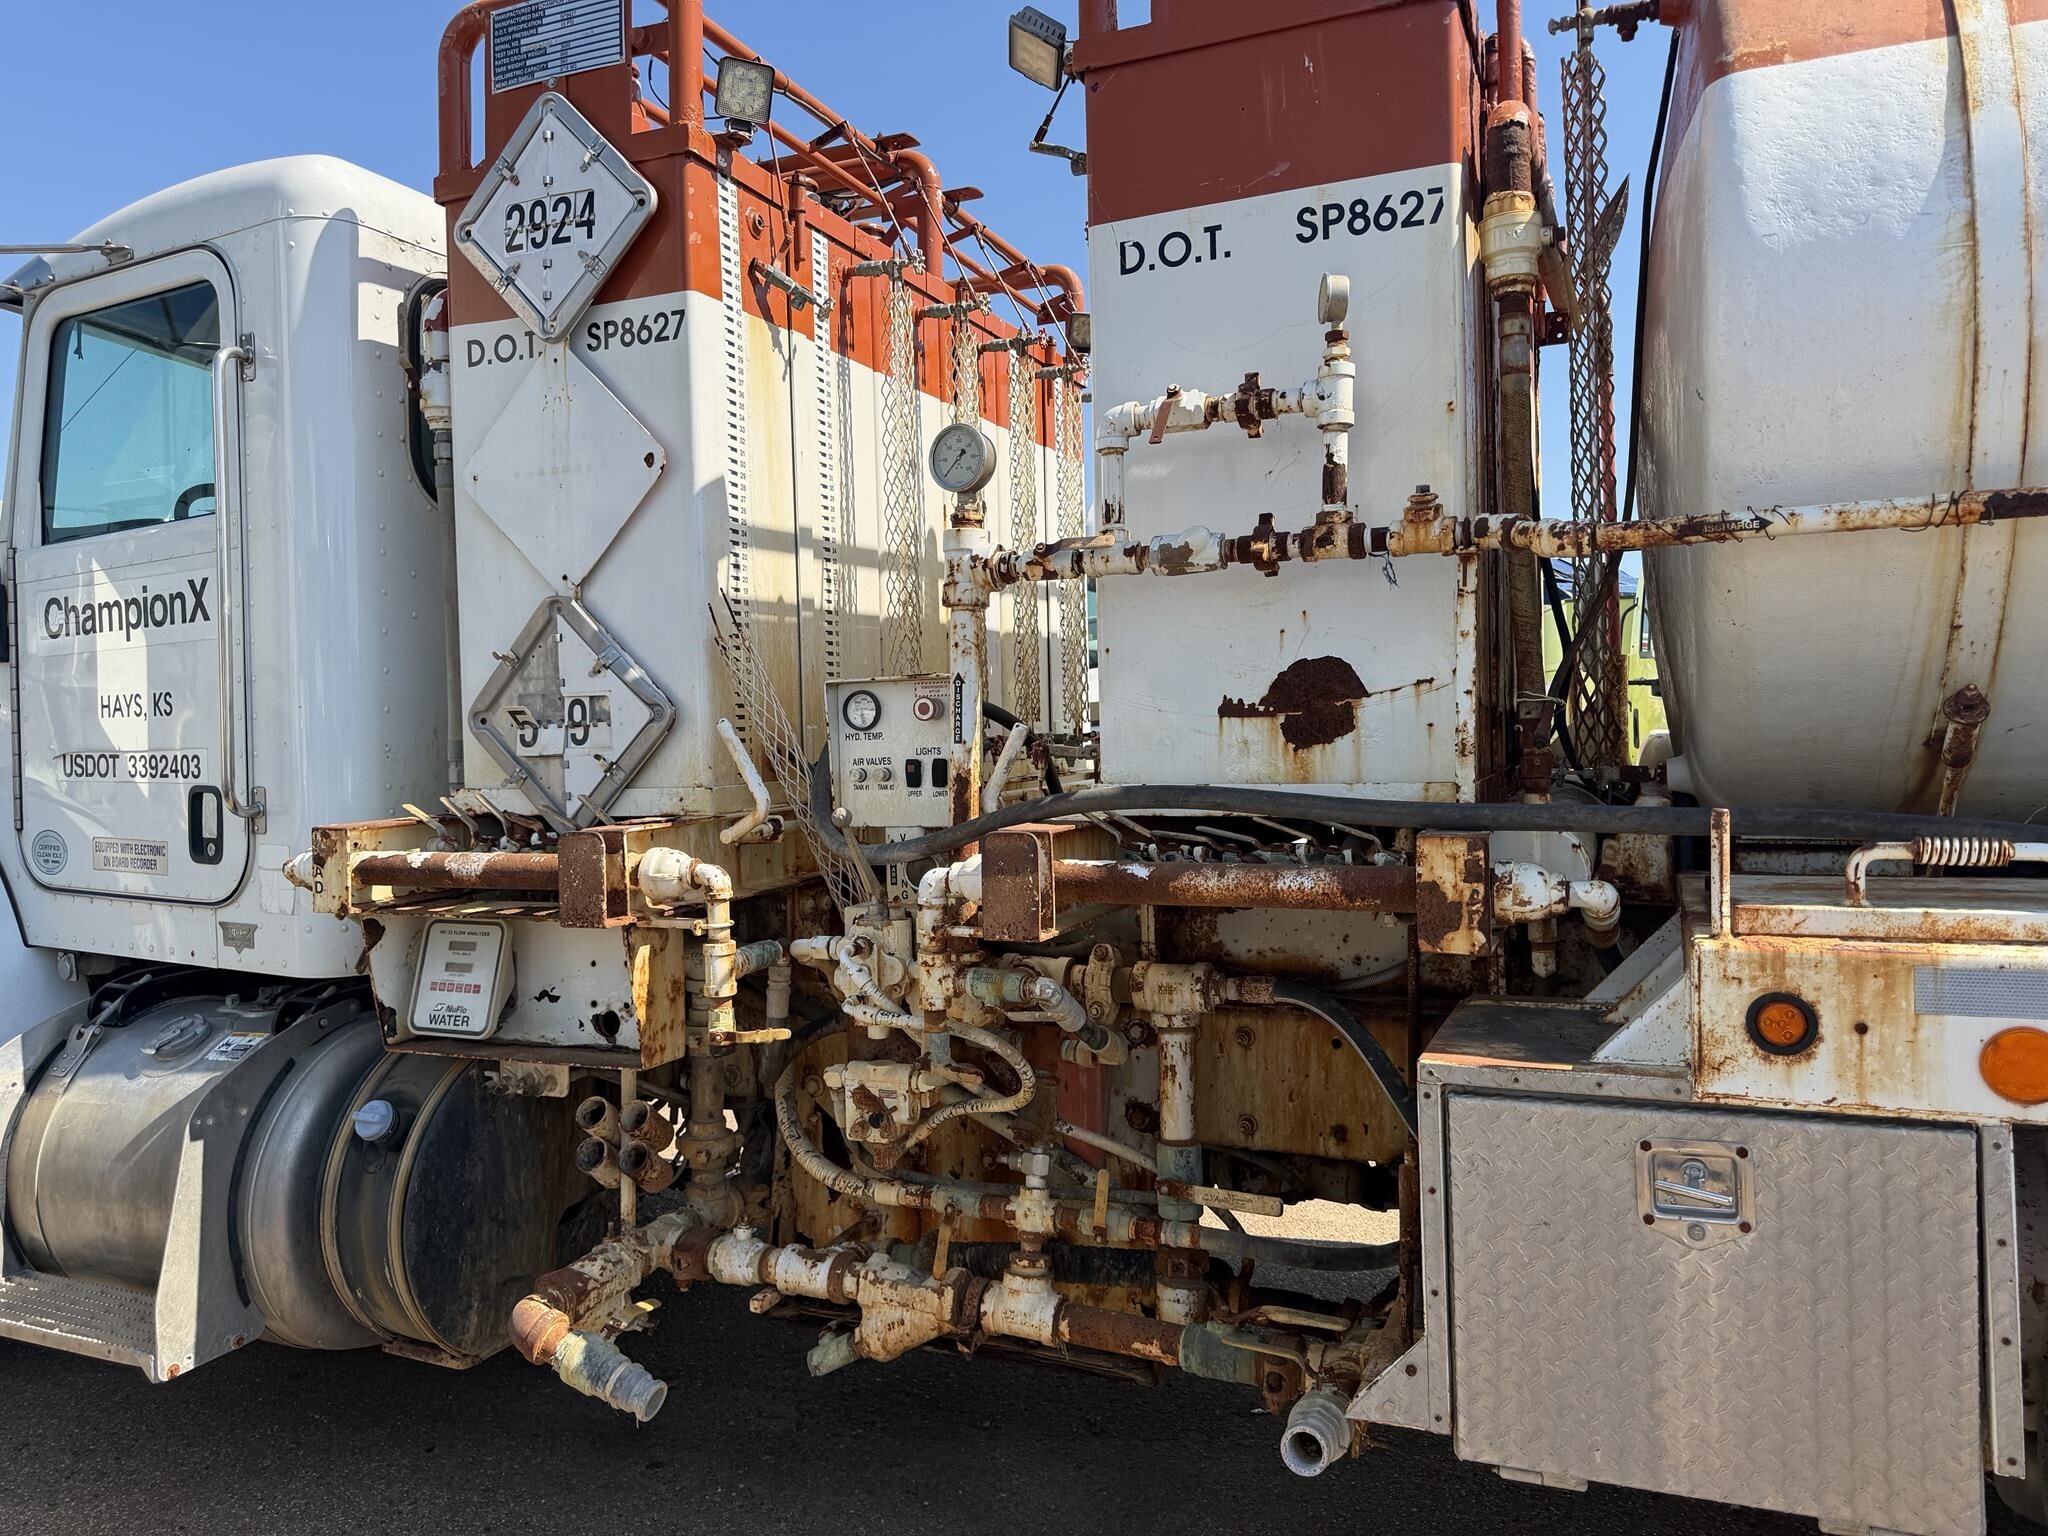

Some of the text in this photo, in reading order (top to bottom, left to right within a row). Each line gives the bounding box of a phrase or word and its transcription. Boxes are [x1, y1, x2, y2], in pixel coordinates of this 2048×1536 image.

[495, 15, 532, 28] MANUFACTURED
[508, 20, 542, 32] SPECIFICATION
[495, 36, 511, 44] DESIGN
[512, 29, 537, 39] PRESSURE
[495, 43, 511, 51] SERIAL
[507, 48, 519, 56] DATE
[495, 49, 546, 66] RATED GROSS WEIGHT
[507, 61, 525, 70] WEIGHT
[496, 70, 523, 81] VOLUMETRIC
[524, 64, 547, 73] CAPACITY
[518, 74, 533, 82] SHELL
[505, 190, 595, 254] 2924
[1119, 186, 1444, 275] D.O.T. SP8627
[467, 310, 686, 368] D.O.T. SP8627
[1703, 520, 1760, 532] ISCHARGE
[43, 577, 211, 642] ChampionX
[100, 692, 173, 721] HAYS, KS
[507, 710, 539, 748] 5
[568, 698, 590, 747] 9
[845, 732, 884, 741] HYD. TEMP.
[916, 747, 941, 755] LIGHTS
[62, 754, 202, 779] USDOT 3392403
[853, 757, 892, 766] AIR VALVES
[95, 842, 166, 856] EQUIPPED WITH ELECTRONIC
[104, 857, 157, 870] ON BOARD RECORDER
[446, 1004, 467, 1014] NuFlo
[429, 1014, 470, 1027] WATER
